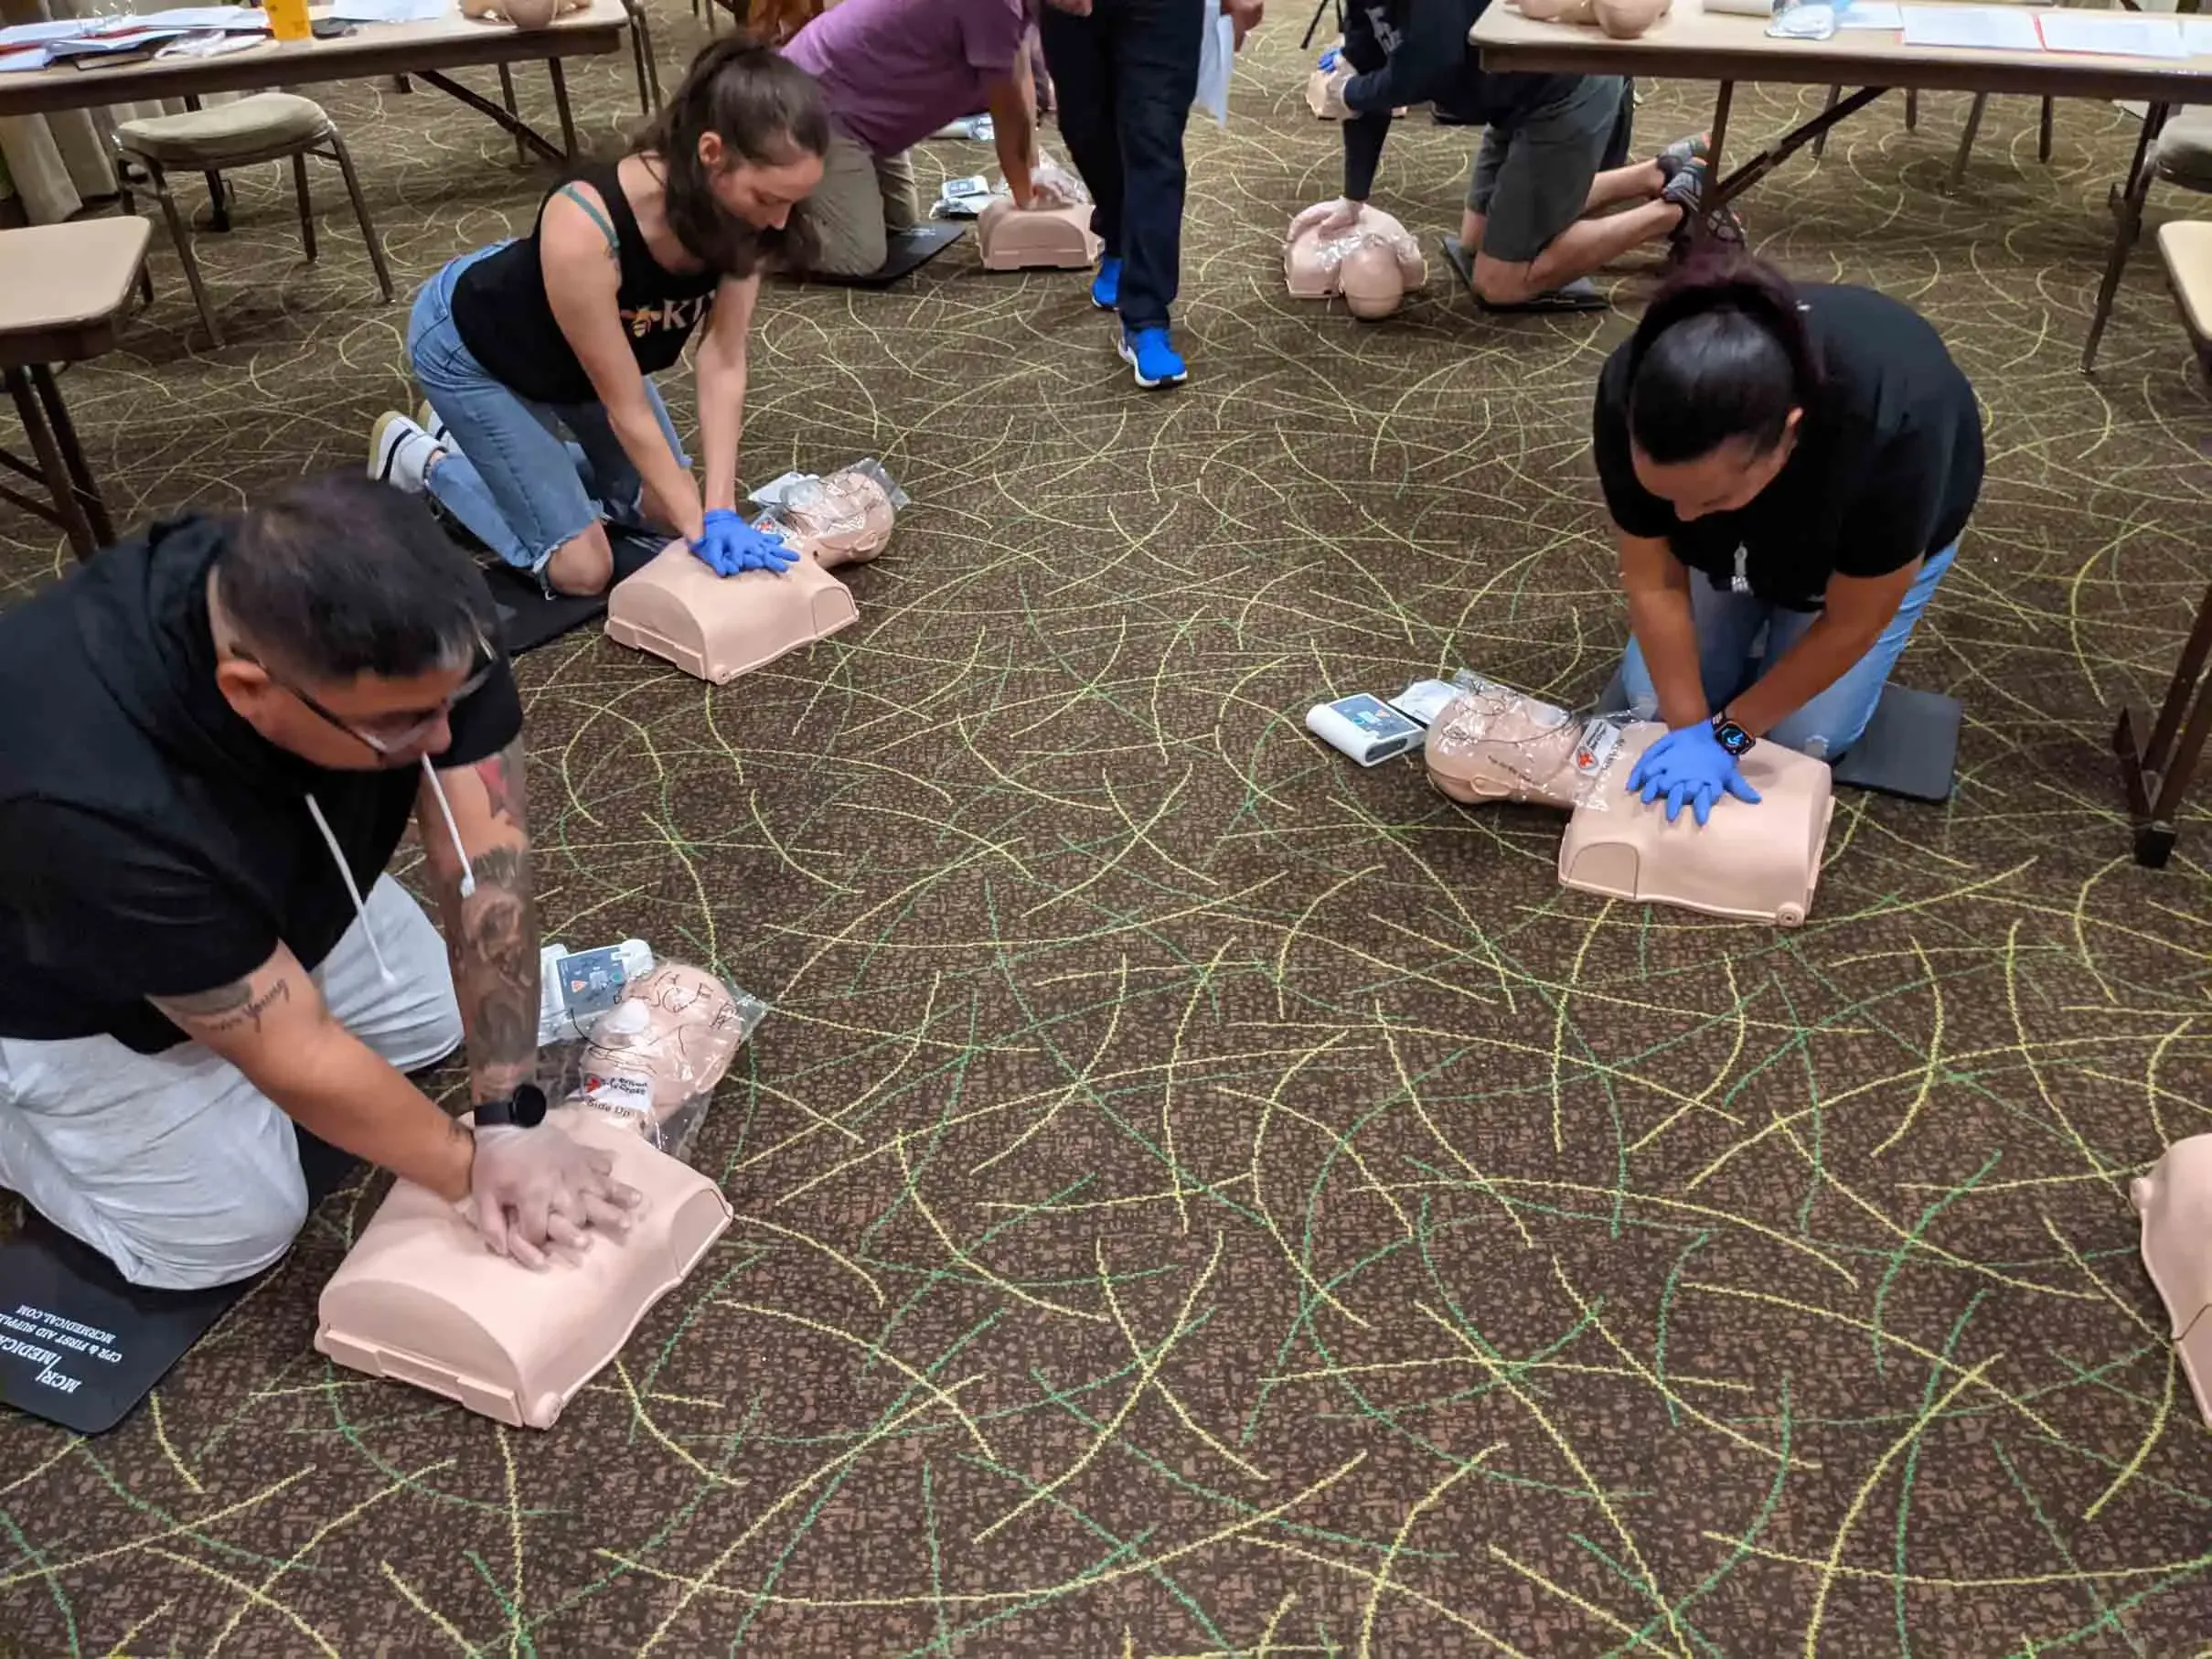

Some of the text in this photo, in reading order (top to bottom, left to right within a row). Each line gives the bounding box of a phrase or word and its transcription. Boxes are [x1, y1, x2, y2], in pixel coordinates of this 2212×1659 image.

[36, 1327, 58, 1340] AID
[55, 1334, 91, 1352] FIRST
[89, 1343, 100, 1355] &
[97, 1348, 123, 1363] CPR
